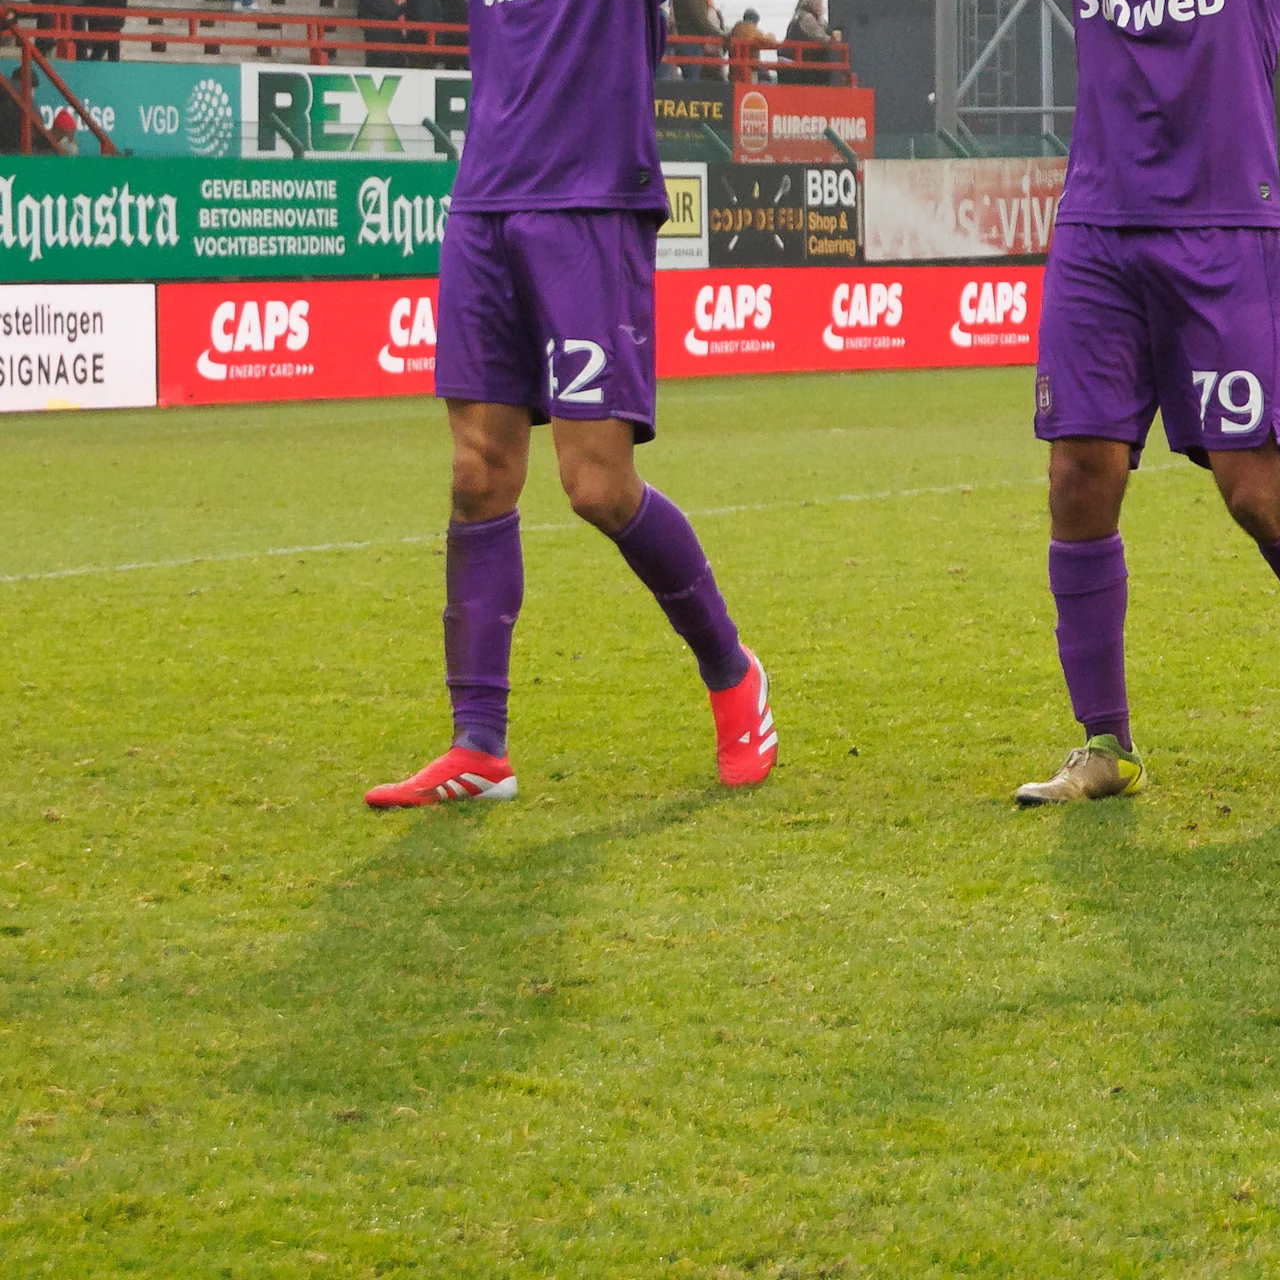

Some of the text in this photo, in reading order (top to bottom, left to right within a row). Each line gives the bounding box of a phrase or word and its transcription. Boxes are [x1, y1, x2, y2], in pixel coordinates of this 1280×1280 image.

[139, 105, 180, 134] VGD
[257, 71, 405, 153] REX
[201, 178, 337, 200] GEVELRENOVATIE
[807, 169, 856, 207] BBQ
[199, 207, 338, 229] BETONRENOVATIE
[710, 206, 752, 234] COUP
[757, 206, 775, 232] DE
[808, 210, 849, 233] Shop &
[193, 235, 346, 257] VOCHTBESTRIJDING
[808, 235, 856, 257] Catering
[695, 284, 773, 331] CAPS
[832, 282, 903, 328] CAPS
[960, 281, 1028, 325] CAPS
[210, 299, 311, 353] CAPS
[229, 363, 295, 379] ENERGY CARD
[1192, 370, 1264, 434] 79
